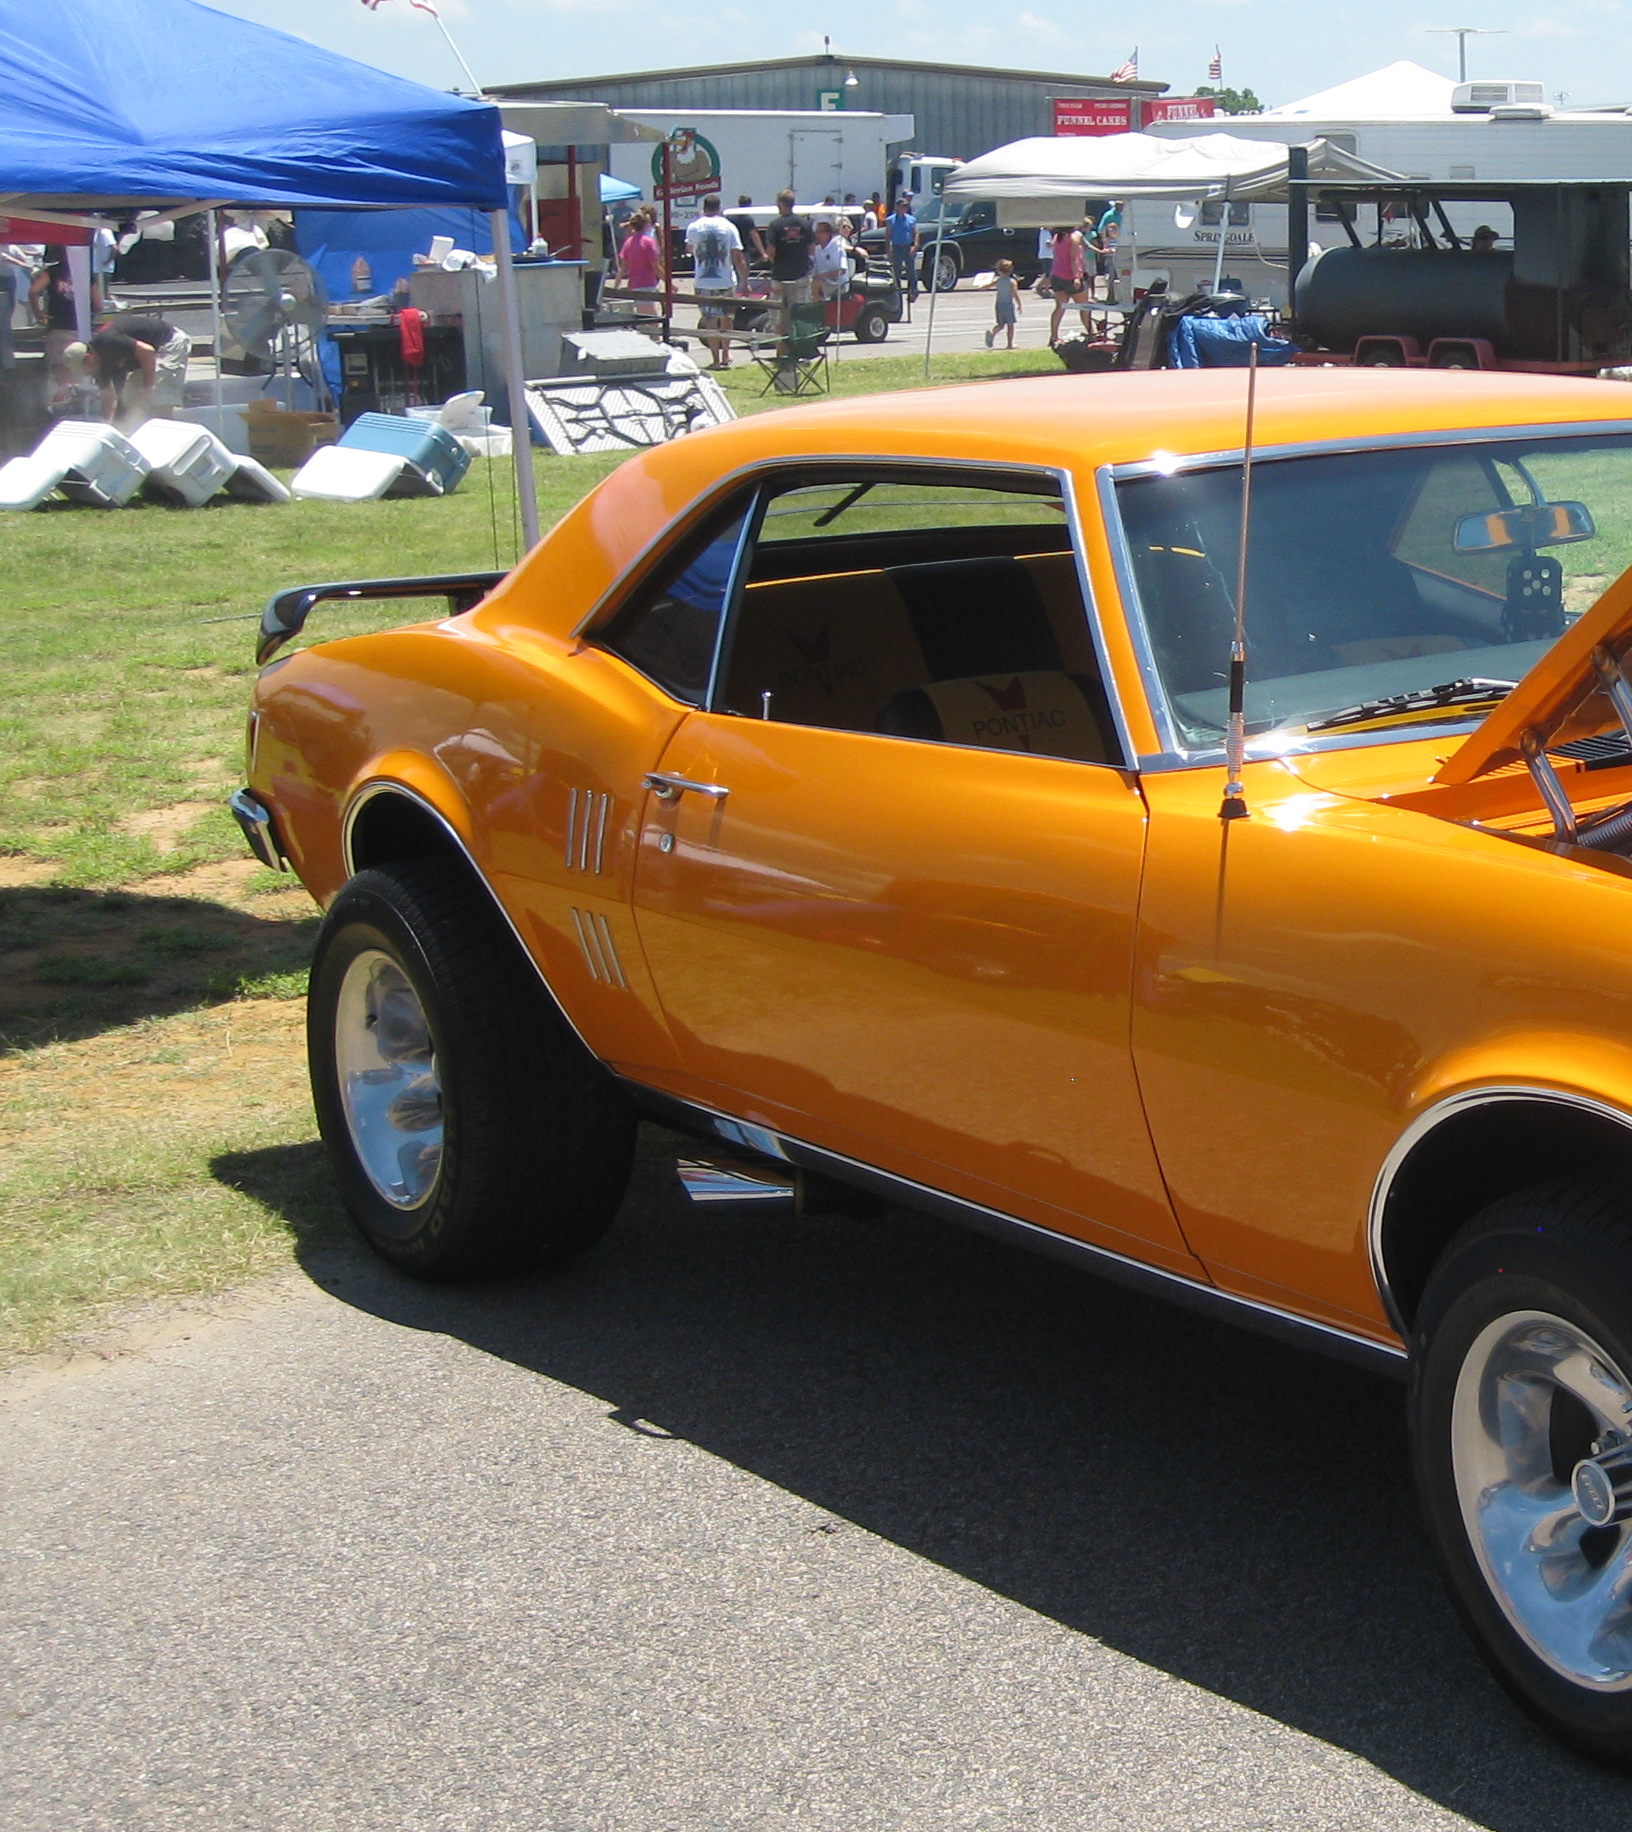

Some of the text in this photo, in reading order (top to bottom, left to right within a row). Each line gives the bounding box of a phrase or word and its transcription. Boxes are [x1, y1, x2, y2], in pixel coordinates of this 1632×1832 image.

[1057, 115, 1127, 125] FUNNEL CAKES
[1167, 104, 1199, 120] FUNNEL
[779, 658, 864, 687] PONTIAC
[973, 709, 1067, 740] PONTIAC
